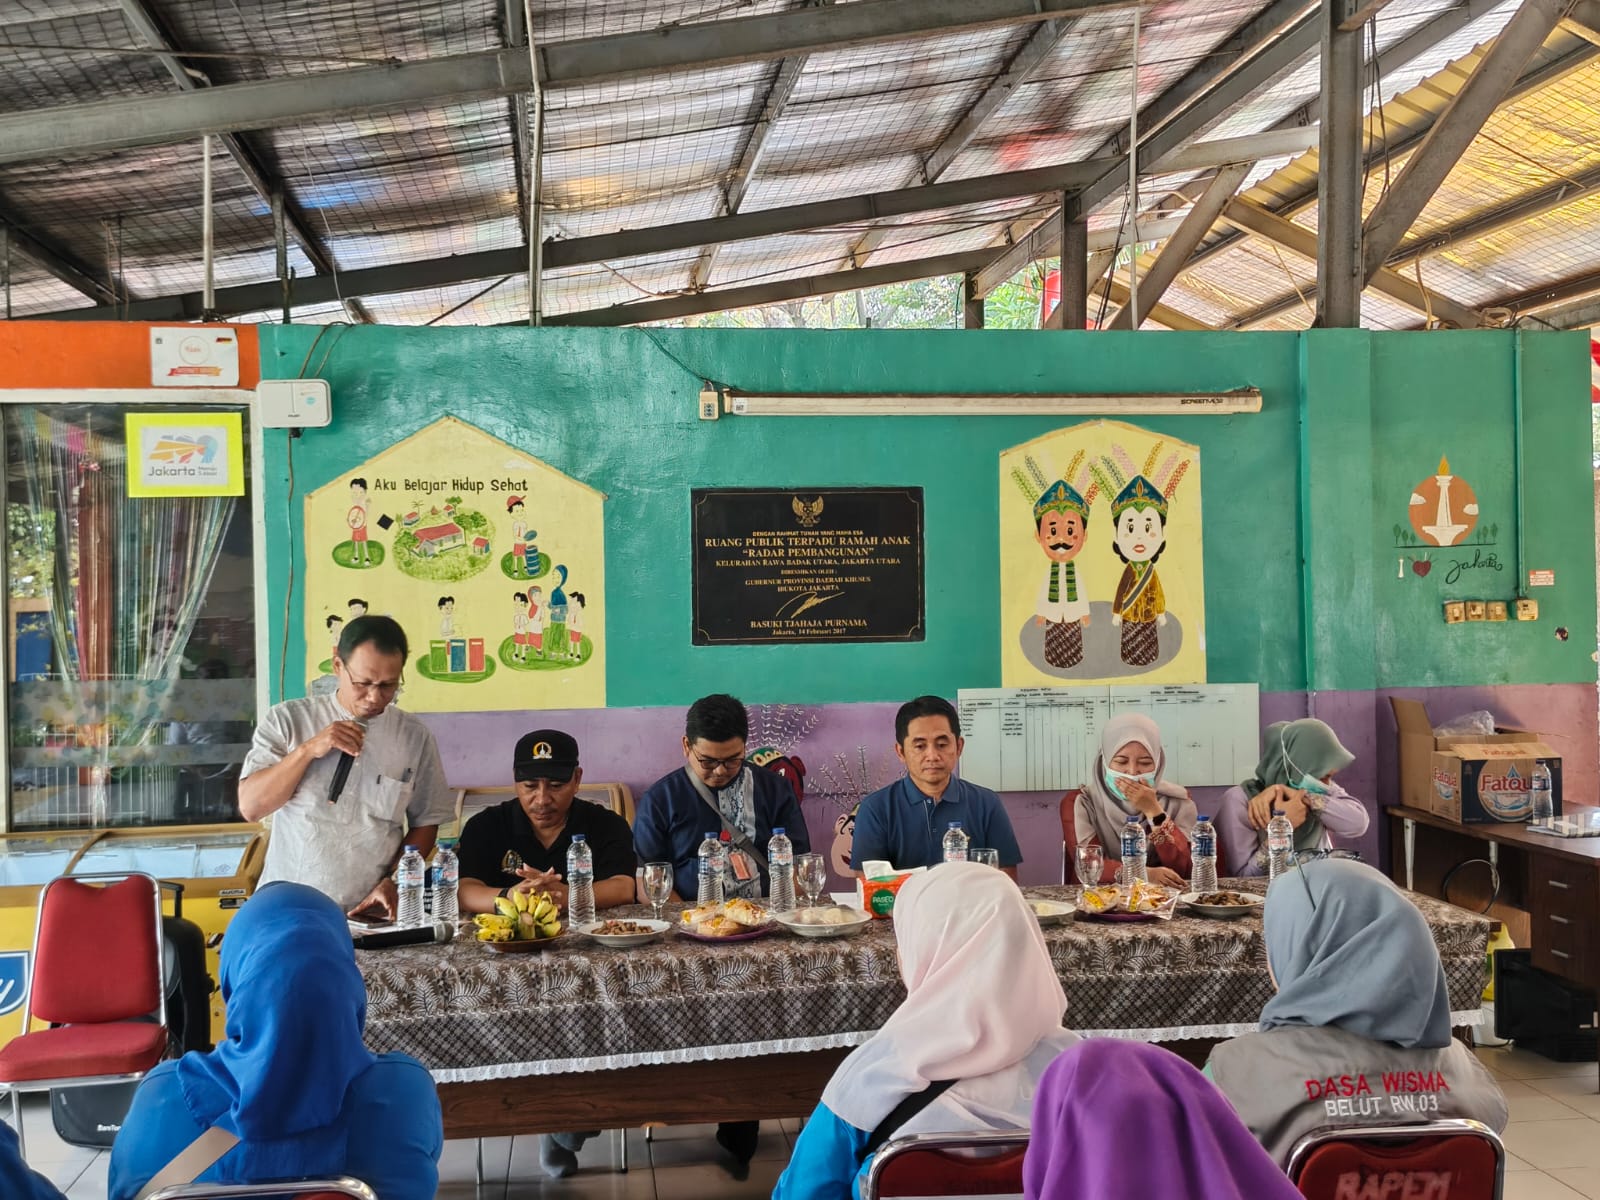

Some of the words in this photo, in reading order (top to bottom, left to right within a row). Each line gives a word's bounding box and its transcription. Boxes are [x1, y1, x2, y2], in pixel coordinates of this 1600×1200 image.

[148, 466, 196, 476] Jakarta
[374, 478, 397, 490] Aku
[404, 478, 447, 495] Belajar
[452, 476, 484, 494] Hidup
[490, 478, 528, 491] Sehat
[705, 538, 742, 547] RUANG
[746, 538, 784, 546] PUBLIK
[787, 537, 836, 546] TERPADU
[840, 536, 878, 545] RAMAH
[881, 536, 911, 545] ANAK
[1305, 1073, 1372, 1100] DASA
[1382, 1071, 1450, 1093] WISMA
[1324, 1097, 1382, 1117] BELUT
[1390, 1095, 1439, 1113] RW.03
